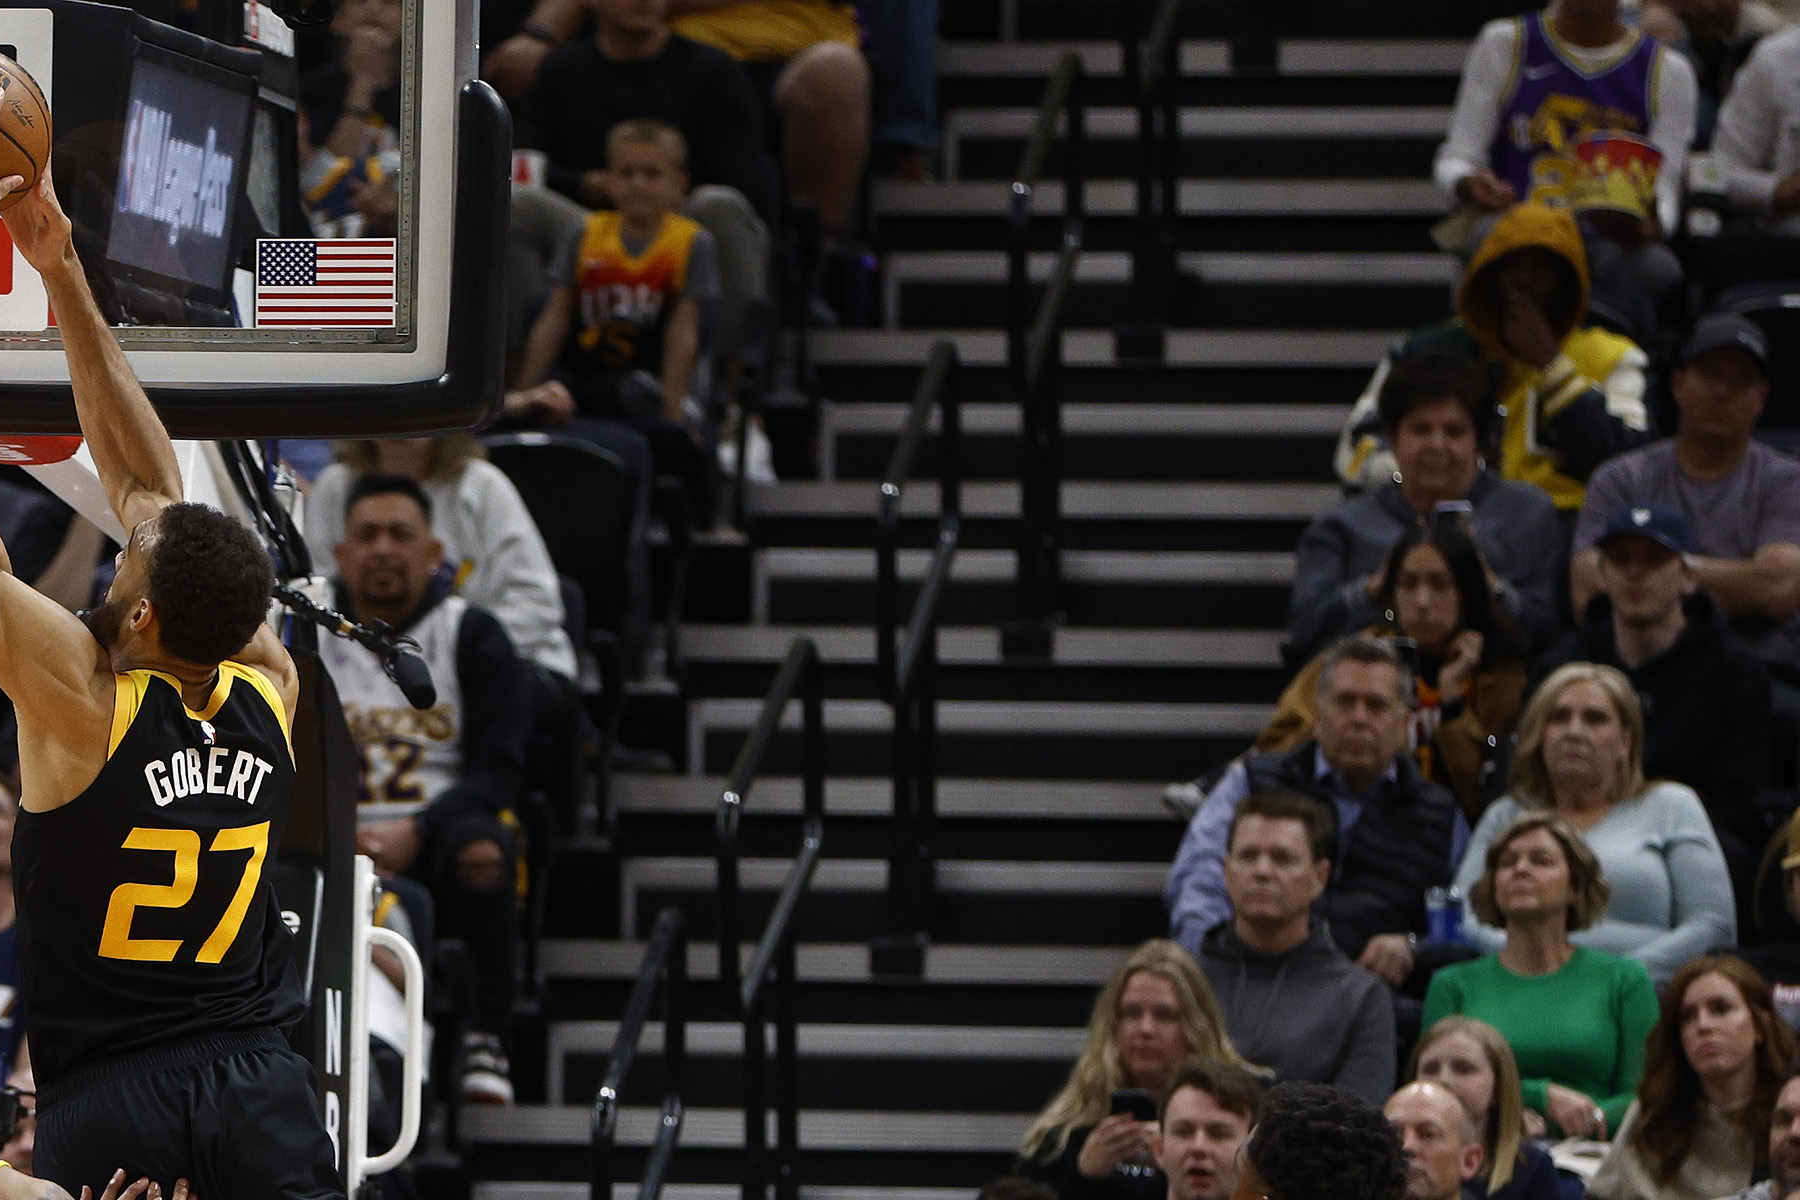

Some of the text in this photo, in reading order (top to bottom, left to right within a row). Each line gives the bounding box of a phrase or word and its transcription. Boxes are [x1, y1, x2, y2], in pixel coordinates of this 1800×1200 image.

[144, 747, 275, 808] GOBERT
[97, 820, 271, 964] 27
[324, 987, 343, 1171] NB
